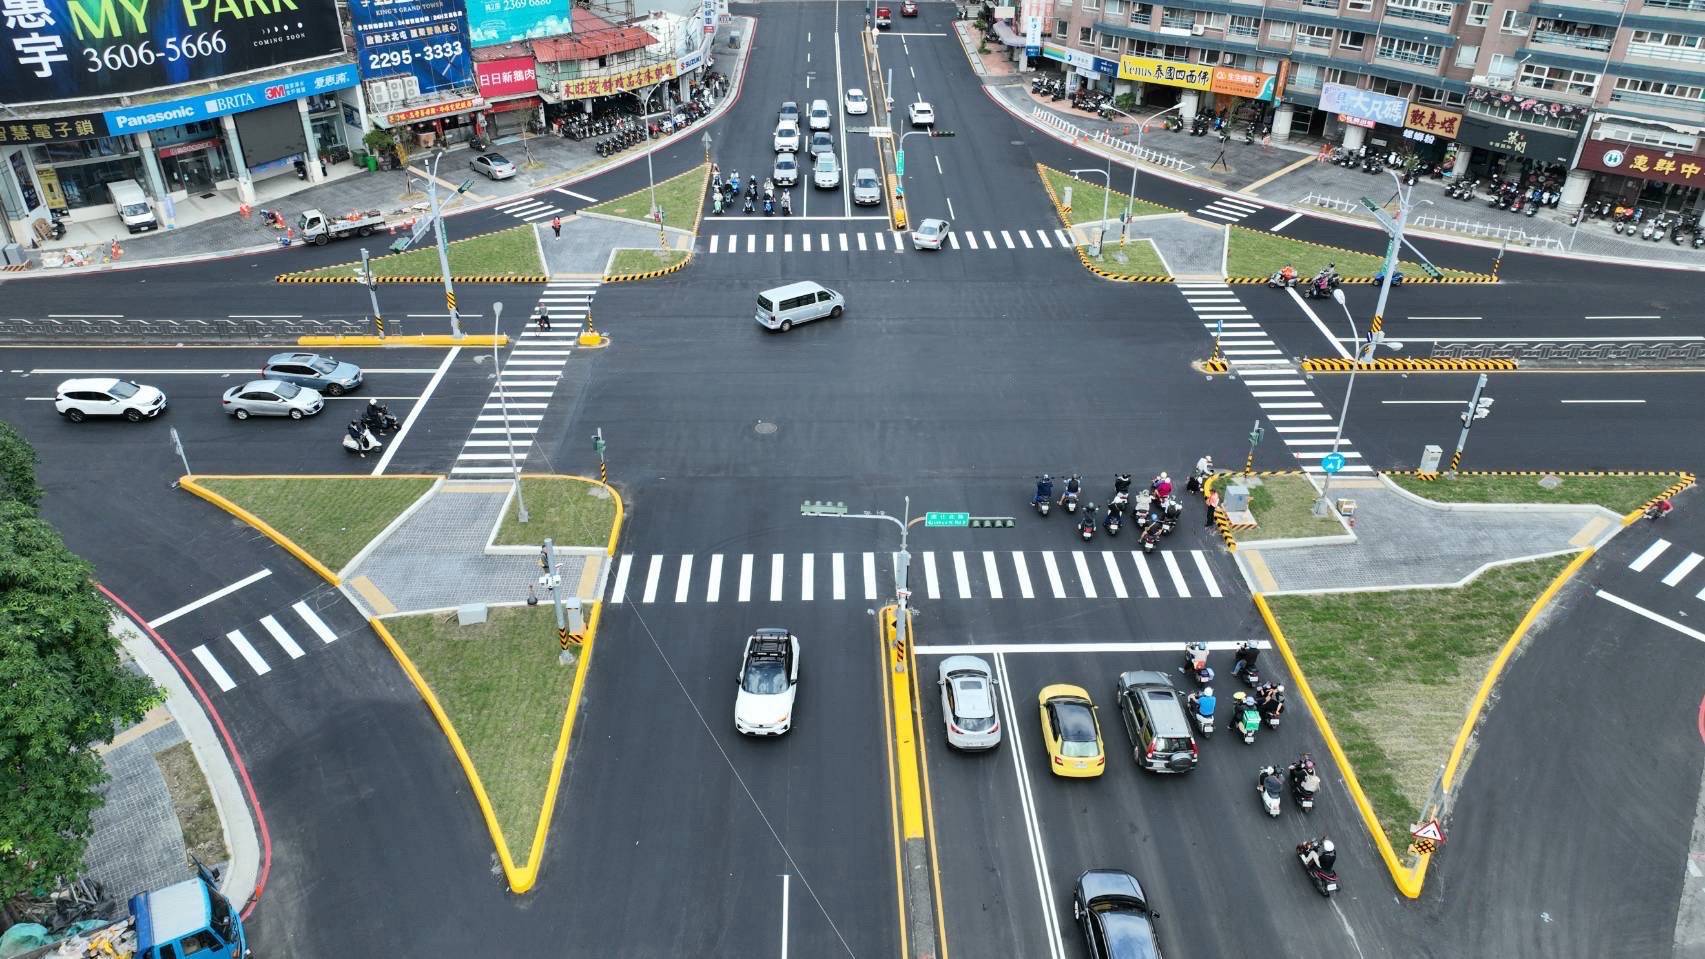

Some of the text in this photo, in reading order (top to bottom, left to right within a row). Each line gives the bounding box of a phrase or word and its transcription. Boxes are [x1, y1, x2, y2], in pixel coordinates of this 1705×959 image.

[398, 5, 421, 14] GRAND
[66, 0, 148, 41] MY
[83, 29, 227, 73] 3606-5666
[253, 36, 283, 47] COMING
[217, 92, 256, 112] BRITA
[264, 84, 286, 100] 3M
[116, 105, 196, 129] Panasonic
